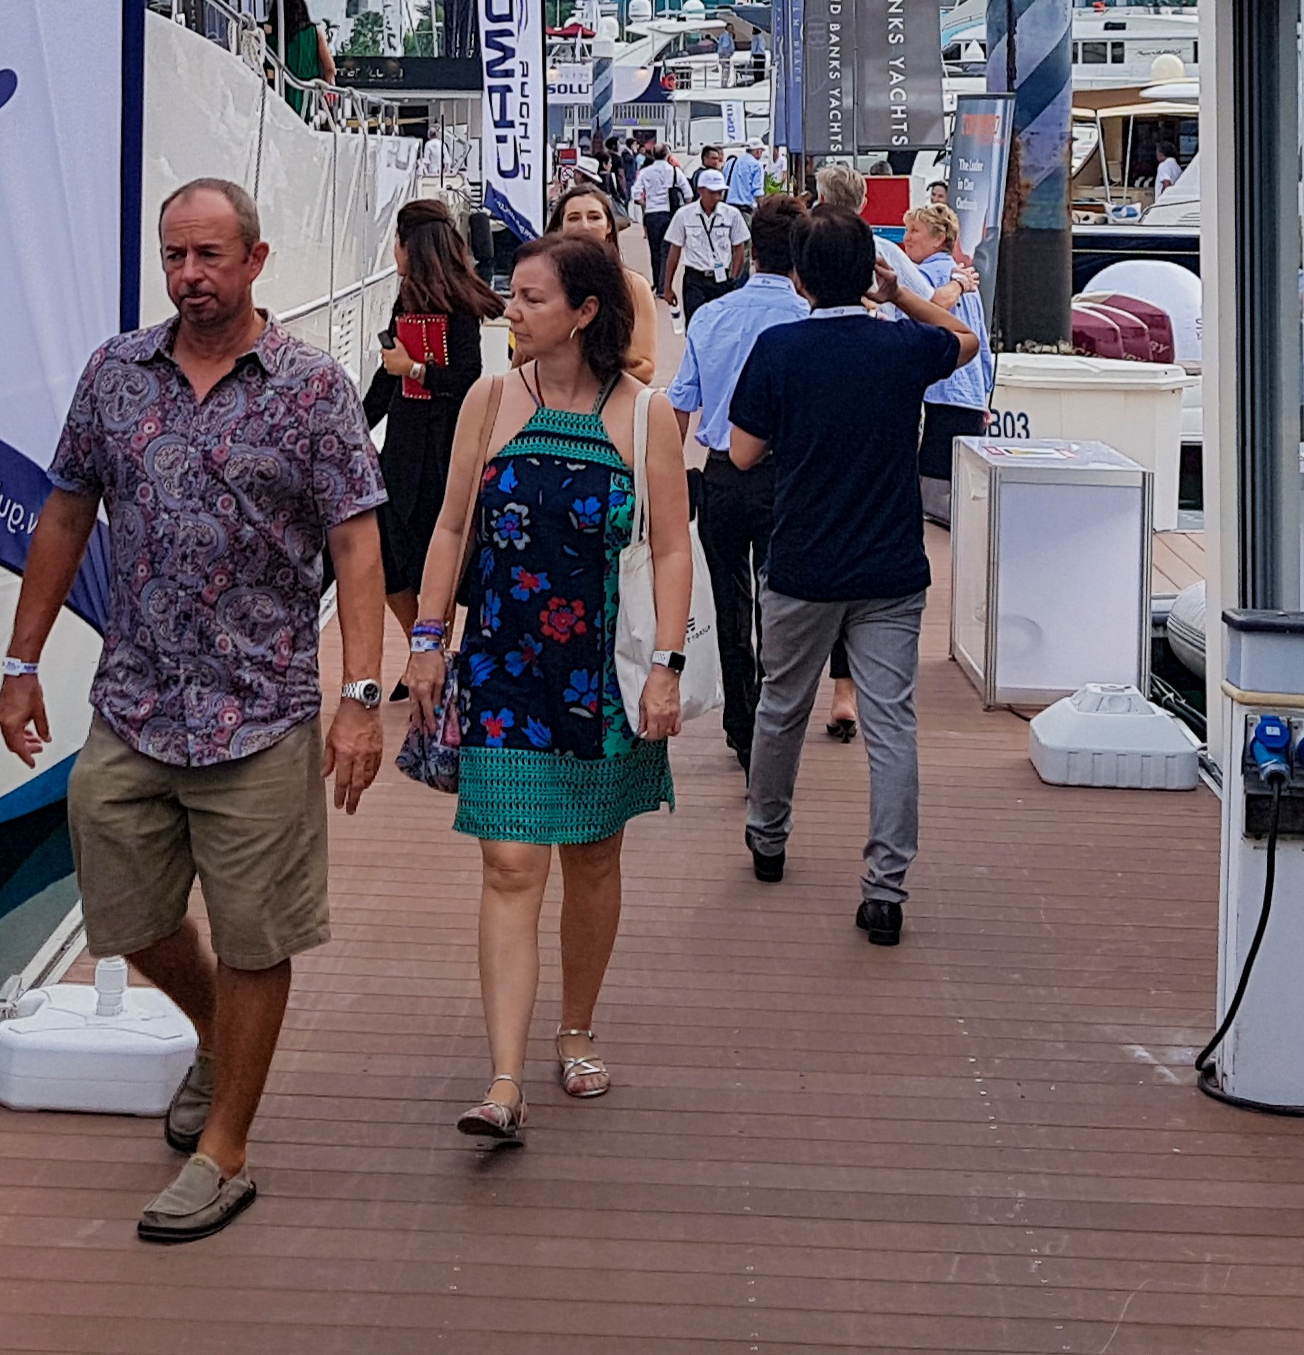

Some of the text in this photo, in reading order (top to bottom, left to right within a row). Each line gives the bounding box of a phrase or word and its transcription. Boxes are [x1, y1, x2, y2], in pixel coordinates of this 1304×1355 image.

[828, 23, 842, 80] BANKS
[828, 88, 843, 152] YACHTS
[888, 56, 909, 146] YACHTS
